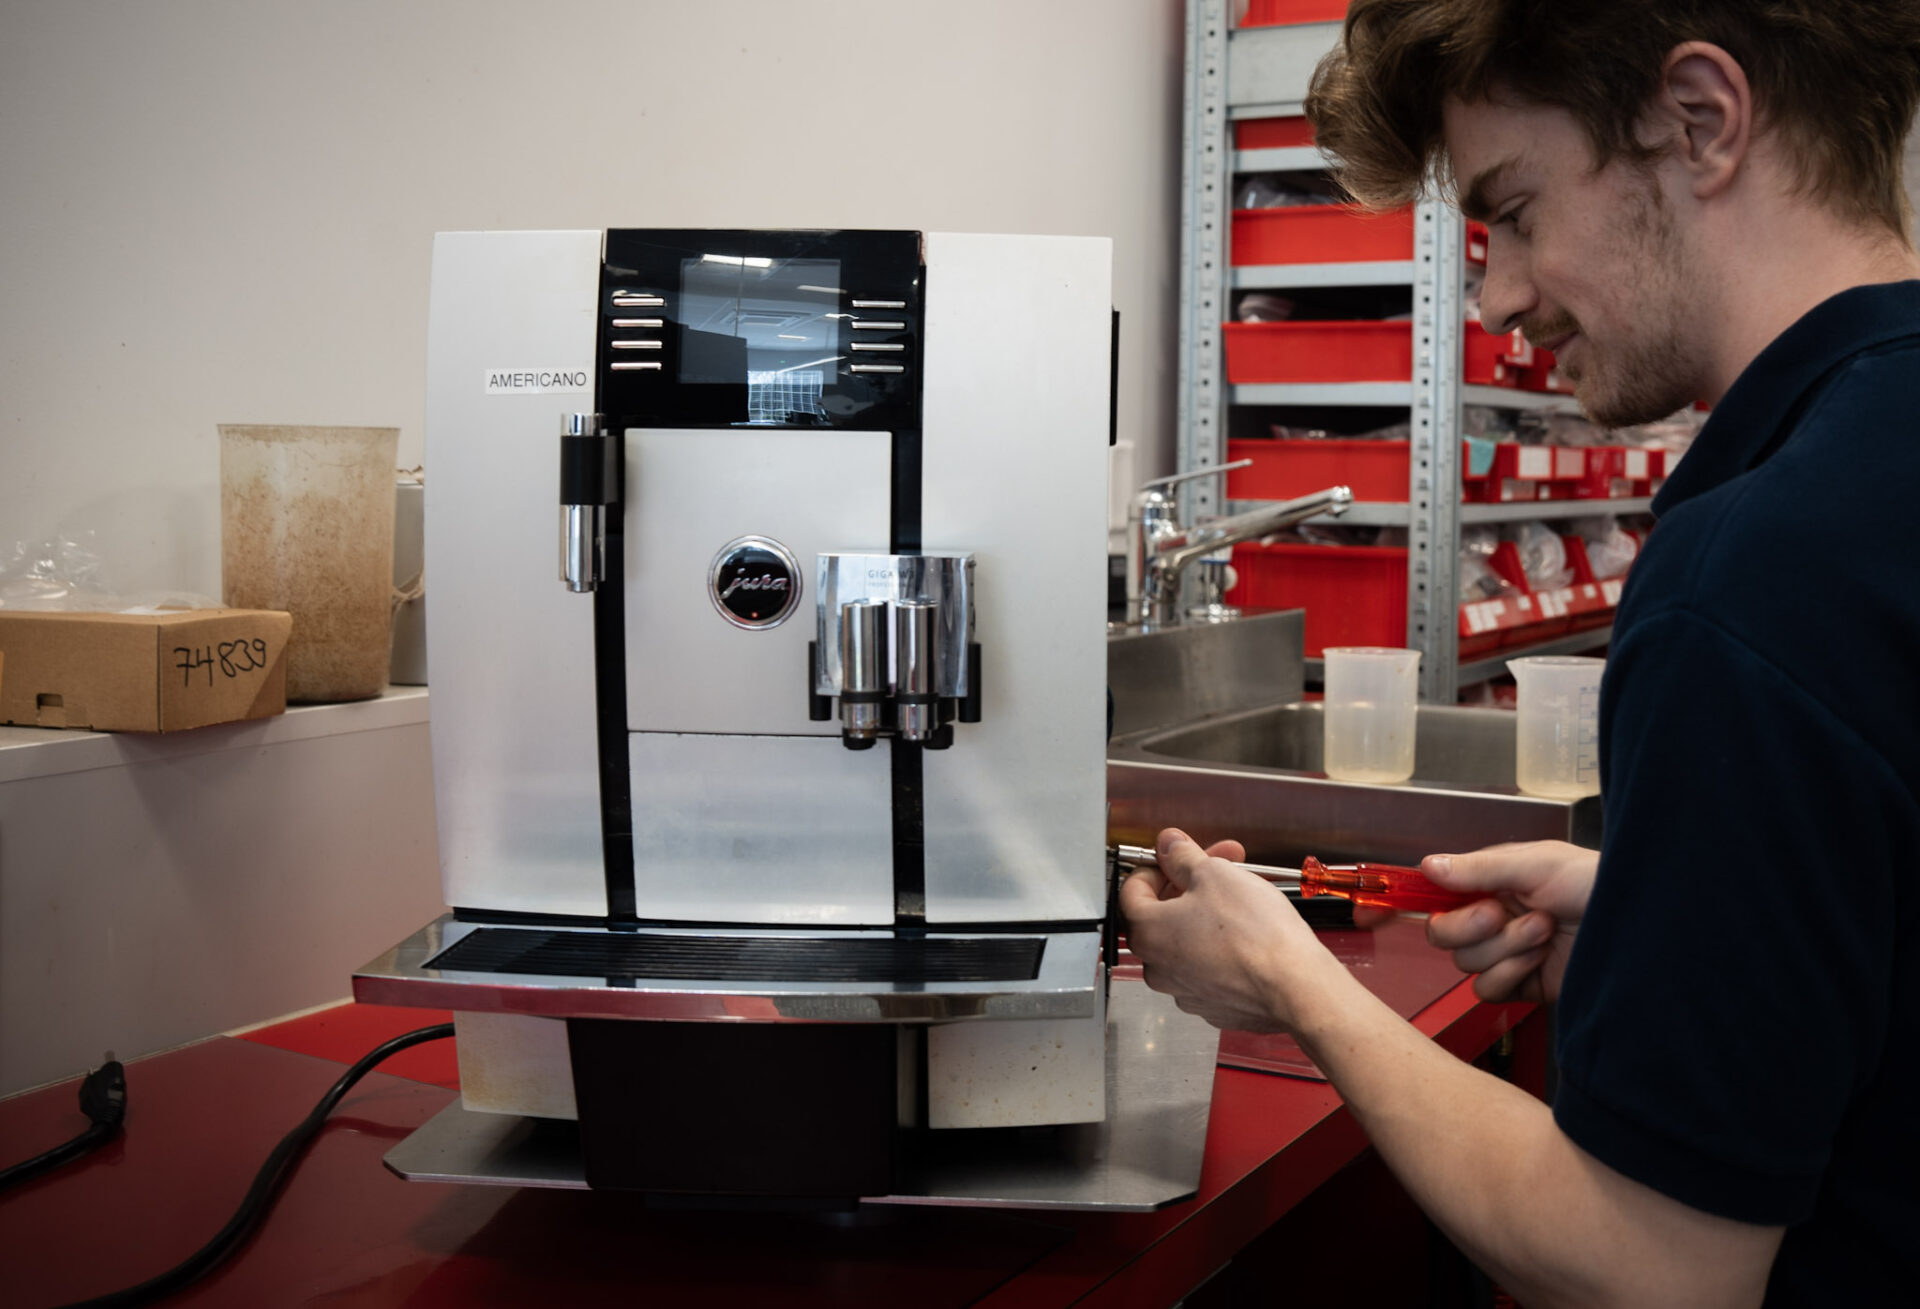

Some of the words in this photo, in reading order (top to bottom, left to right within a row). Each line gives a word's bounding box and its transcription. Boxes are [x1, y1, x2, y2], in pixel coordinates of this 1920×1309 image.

[489, 372, 587, 387] AMERICANO
[720, 568, 788, 600] jura
[868, 569, 893, 578] GIGA
[173, 638, 266, 688] 74839
